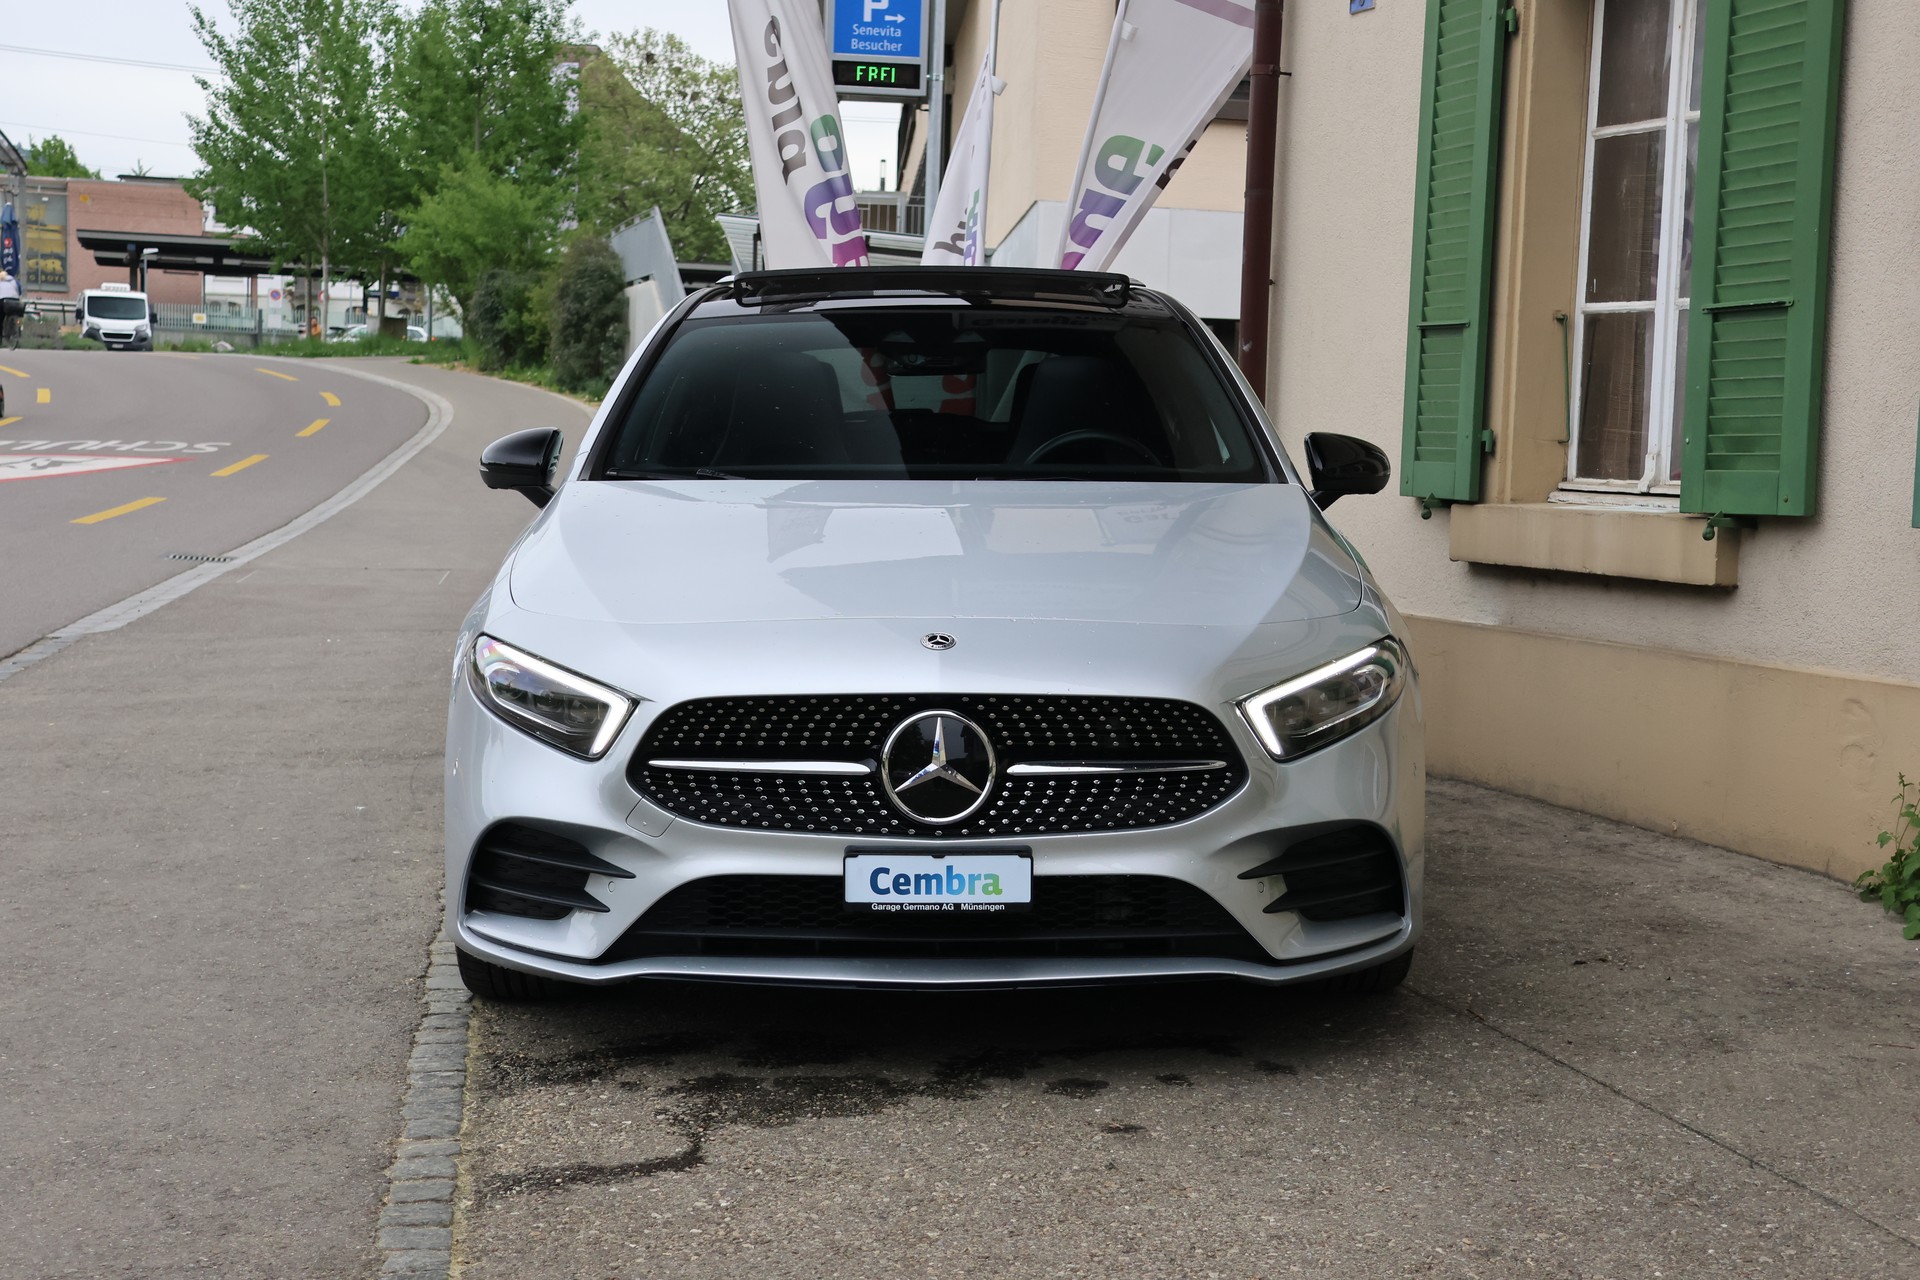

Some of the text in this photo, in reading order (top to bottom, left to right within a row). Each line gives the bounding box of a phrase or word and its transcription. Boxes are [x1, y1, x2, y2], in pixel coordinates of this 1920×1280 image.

[852, 24, 902, 37] Senevita
[851, 38, 903, 52] Besucher
[0, 440, 231, 453] SCHUL
[870, 865, 1003, 896] Cembra
[871, 903, 901, 911] Garage
[960, 902, 1005, 911] Münsingen
